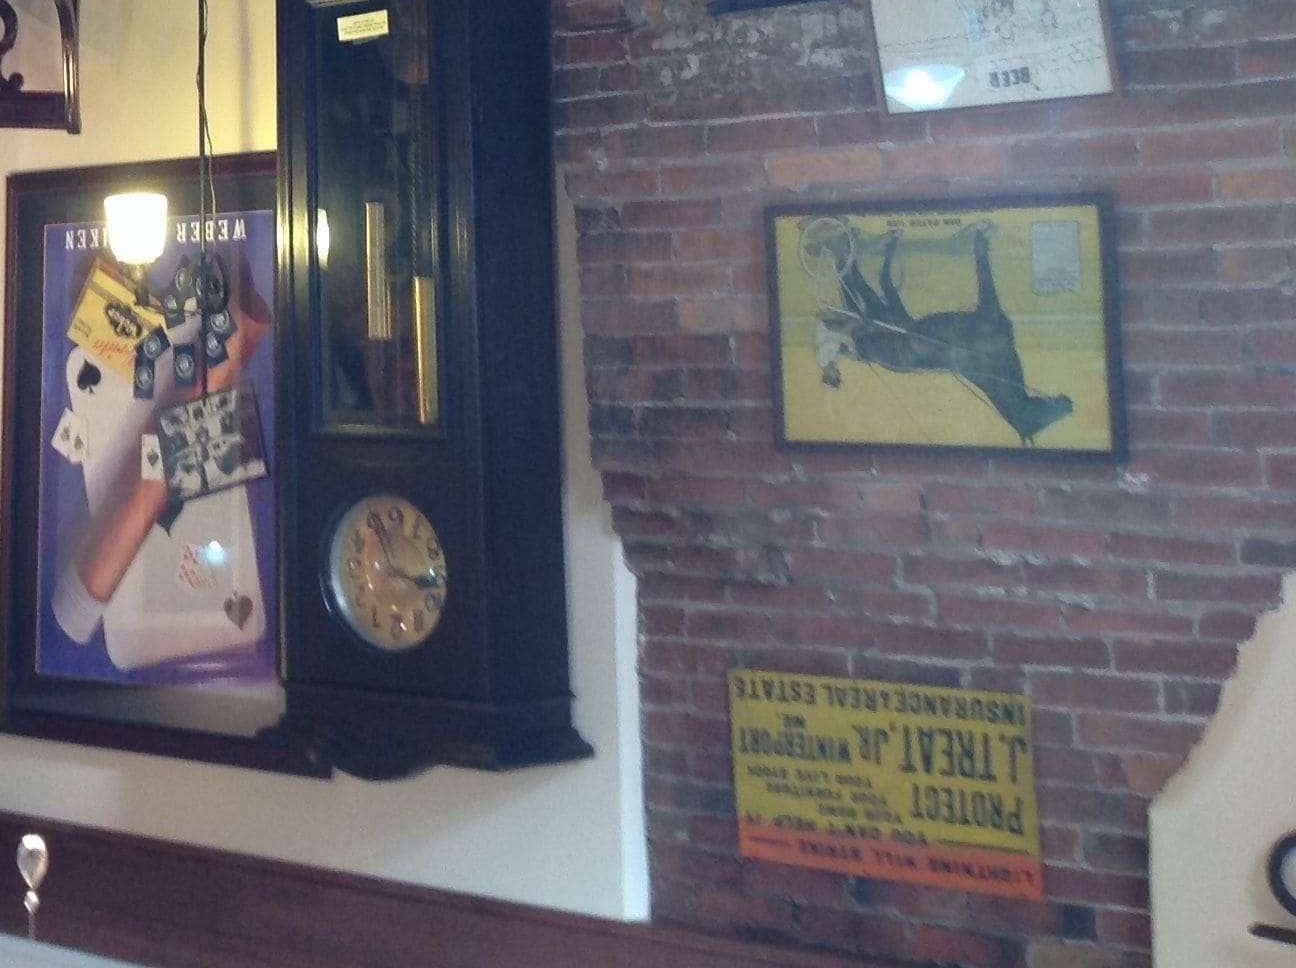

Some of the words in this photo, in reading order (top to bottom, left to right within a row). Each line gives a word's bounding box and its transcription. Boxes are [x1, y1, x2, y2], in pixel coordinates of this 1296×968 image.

[988, 66, 1031, 90] BEER
[175, 218, 247, 245] WEBER
[733, 676, 817, 706] ESTATE
[909, 783, 1025, 836] PROTECT
